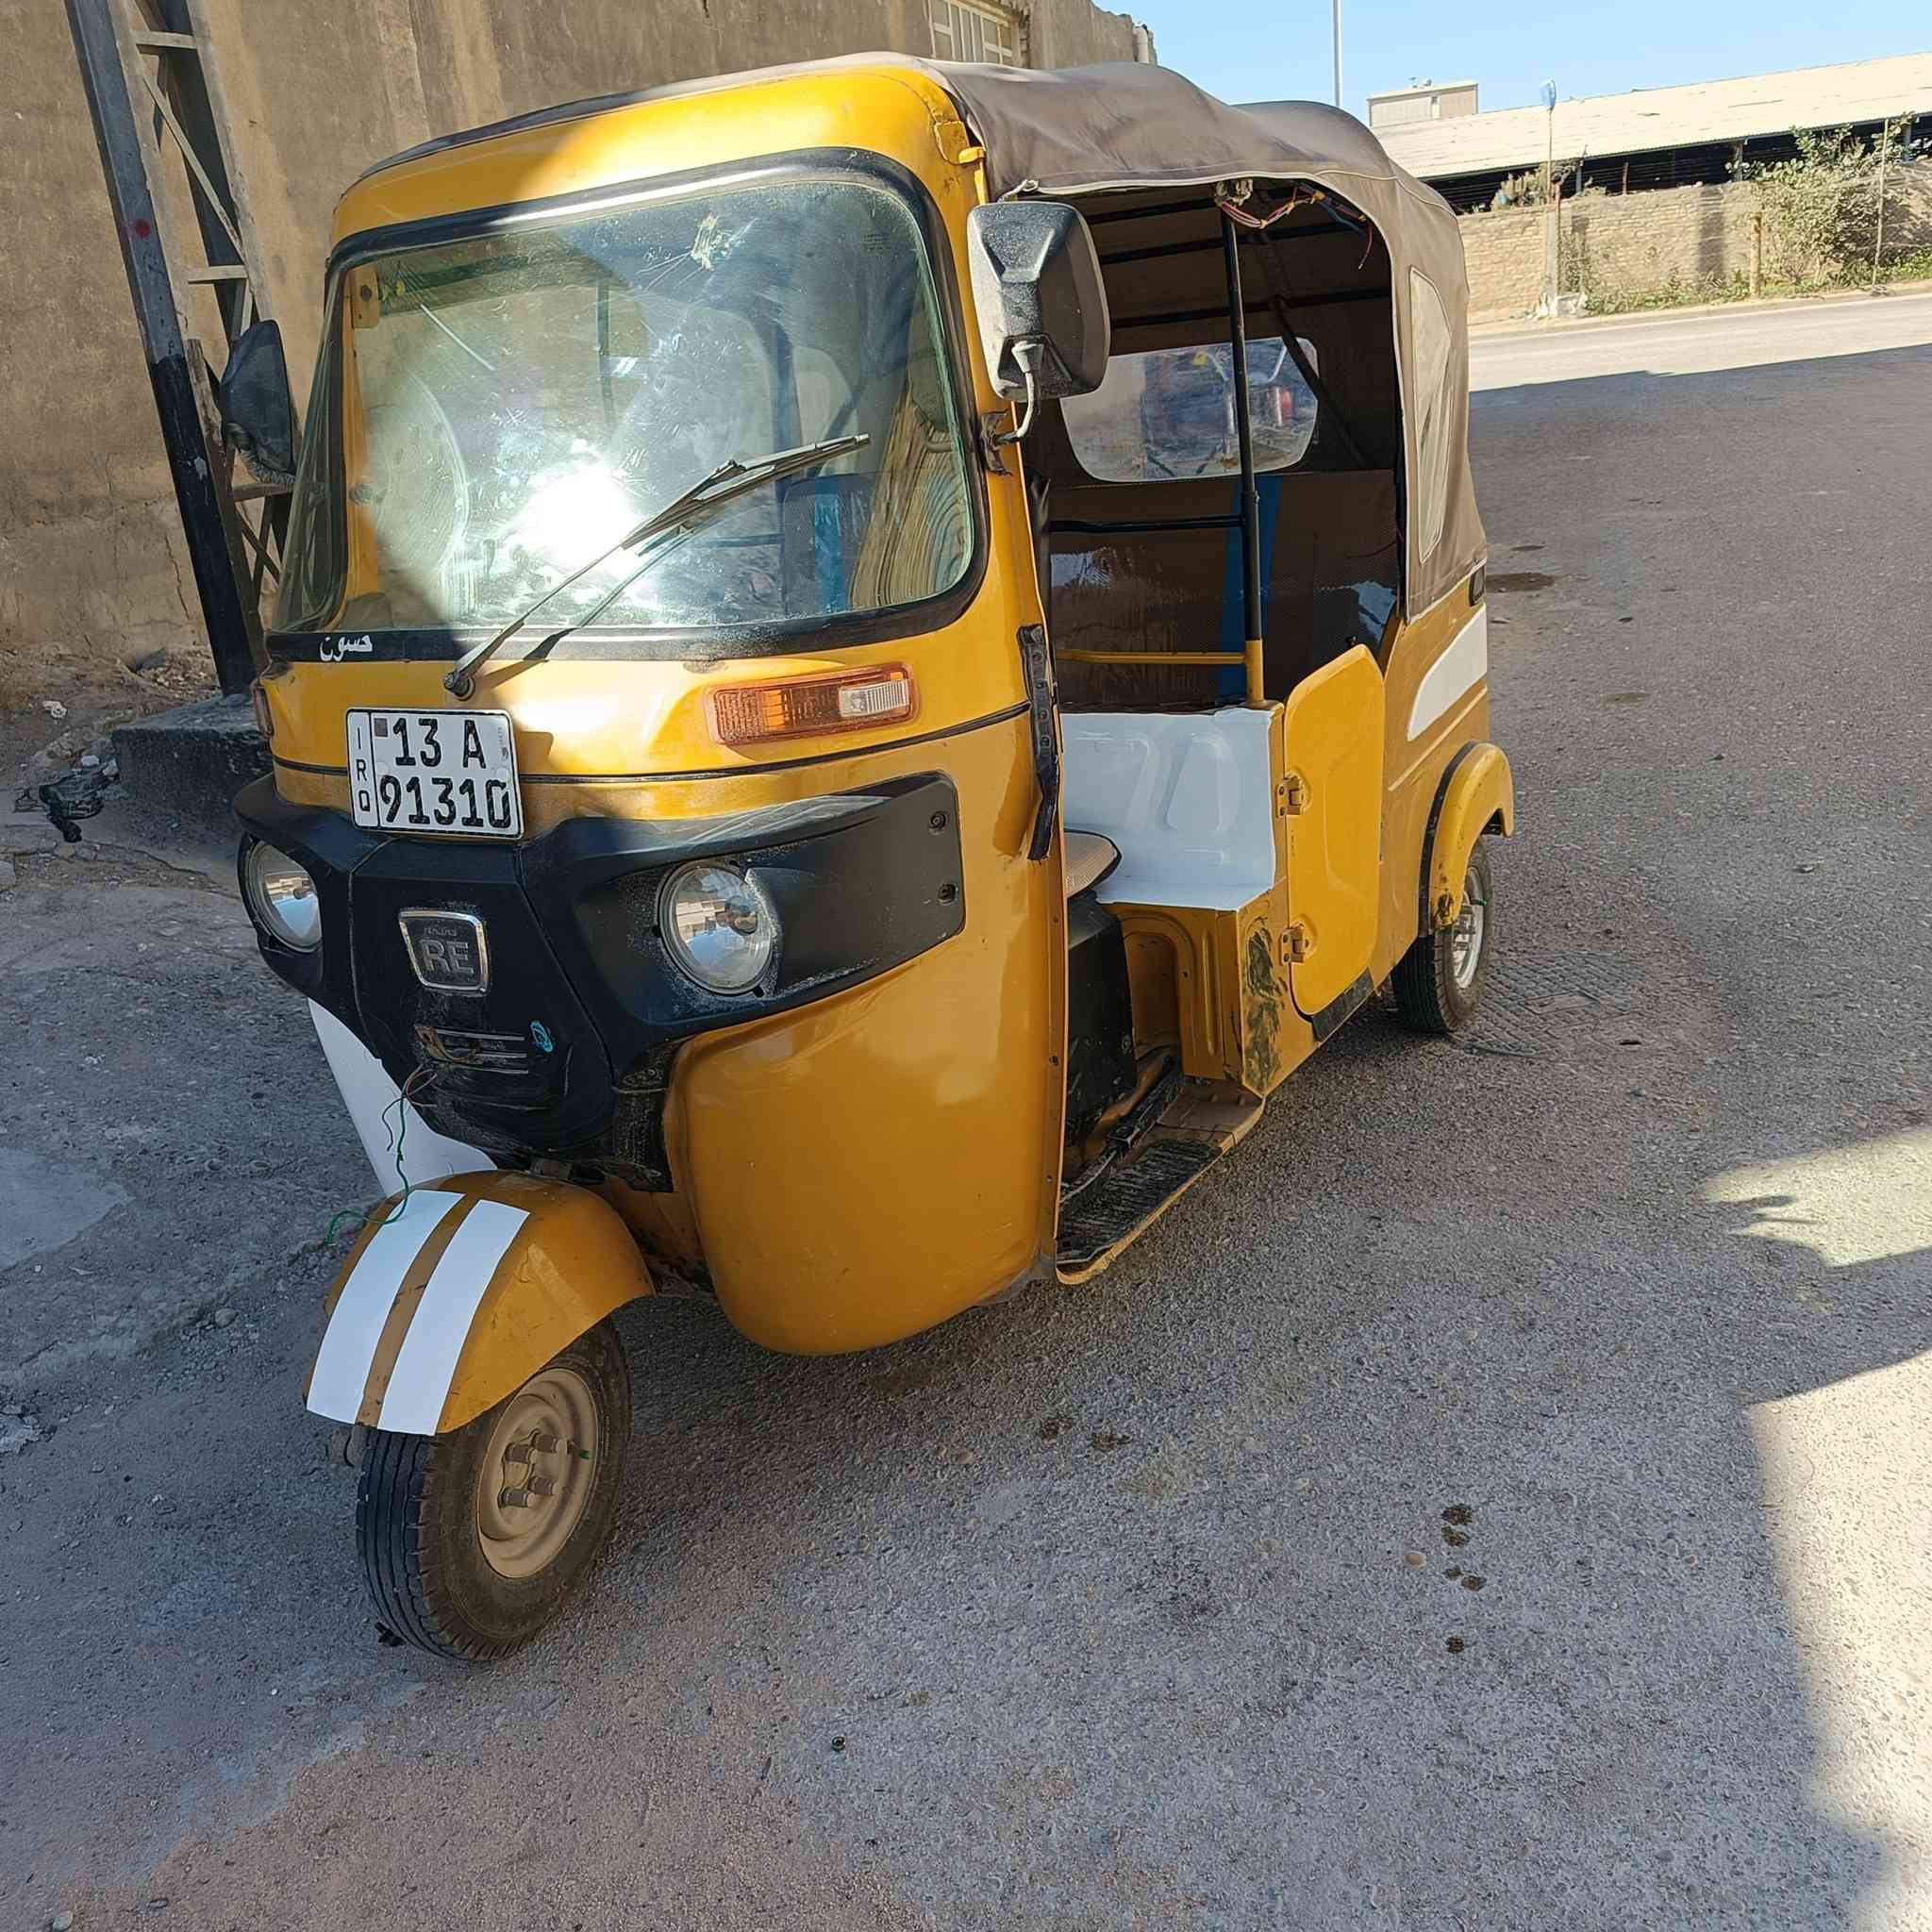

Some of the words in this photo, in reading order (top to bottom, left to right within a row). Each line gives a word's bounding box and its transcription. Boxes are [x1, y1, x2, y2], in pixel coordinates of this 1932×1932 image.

[320, 635, 374, 662] حسون
[392, 717, 442, 768] 13
[462, 719, 487, 769] A
[379, 774, 511, 829] 91310
[419, 939, 475, 974] RE
